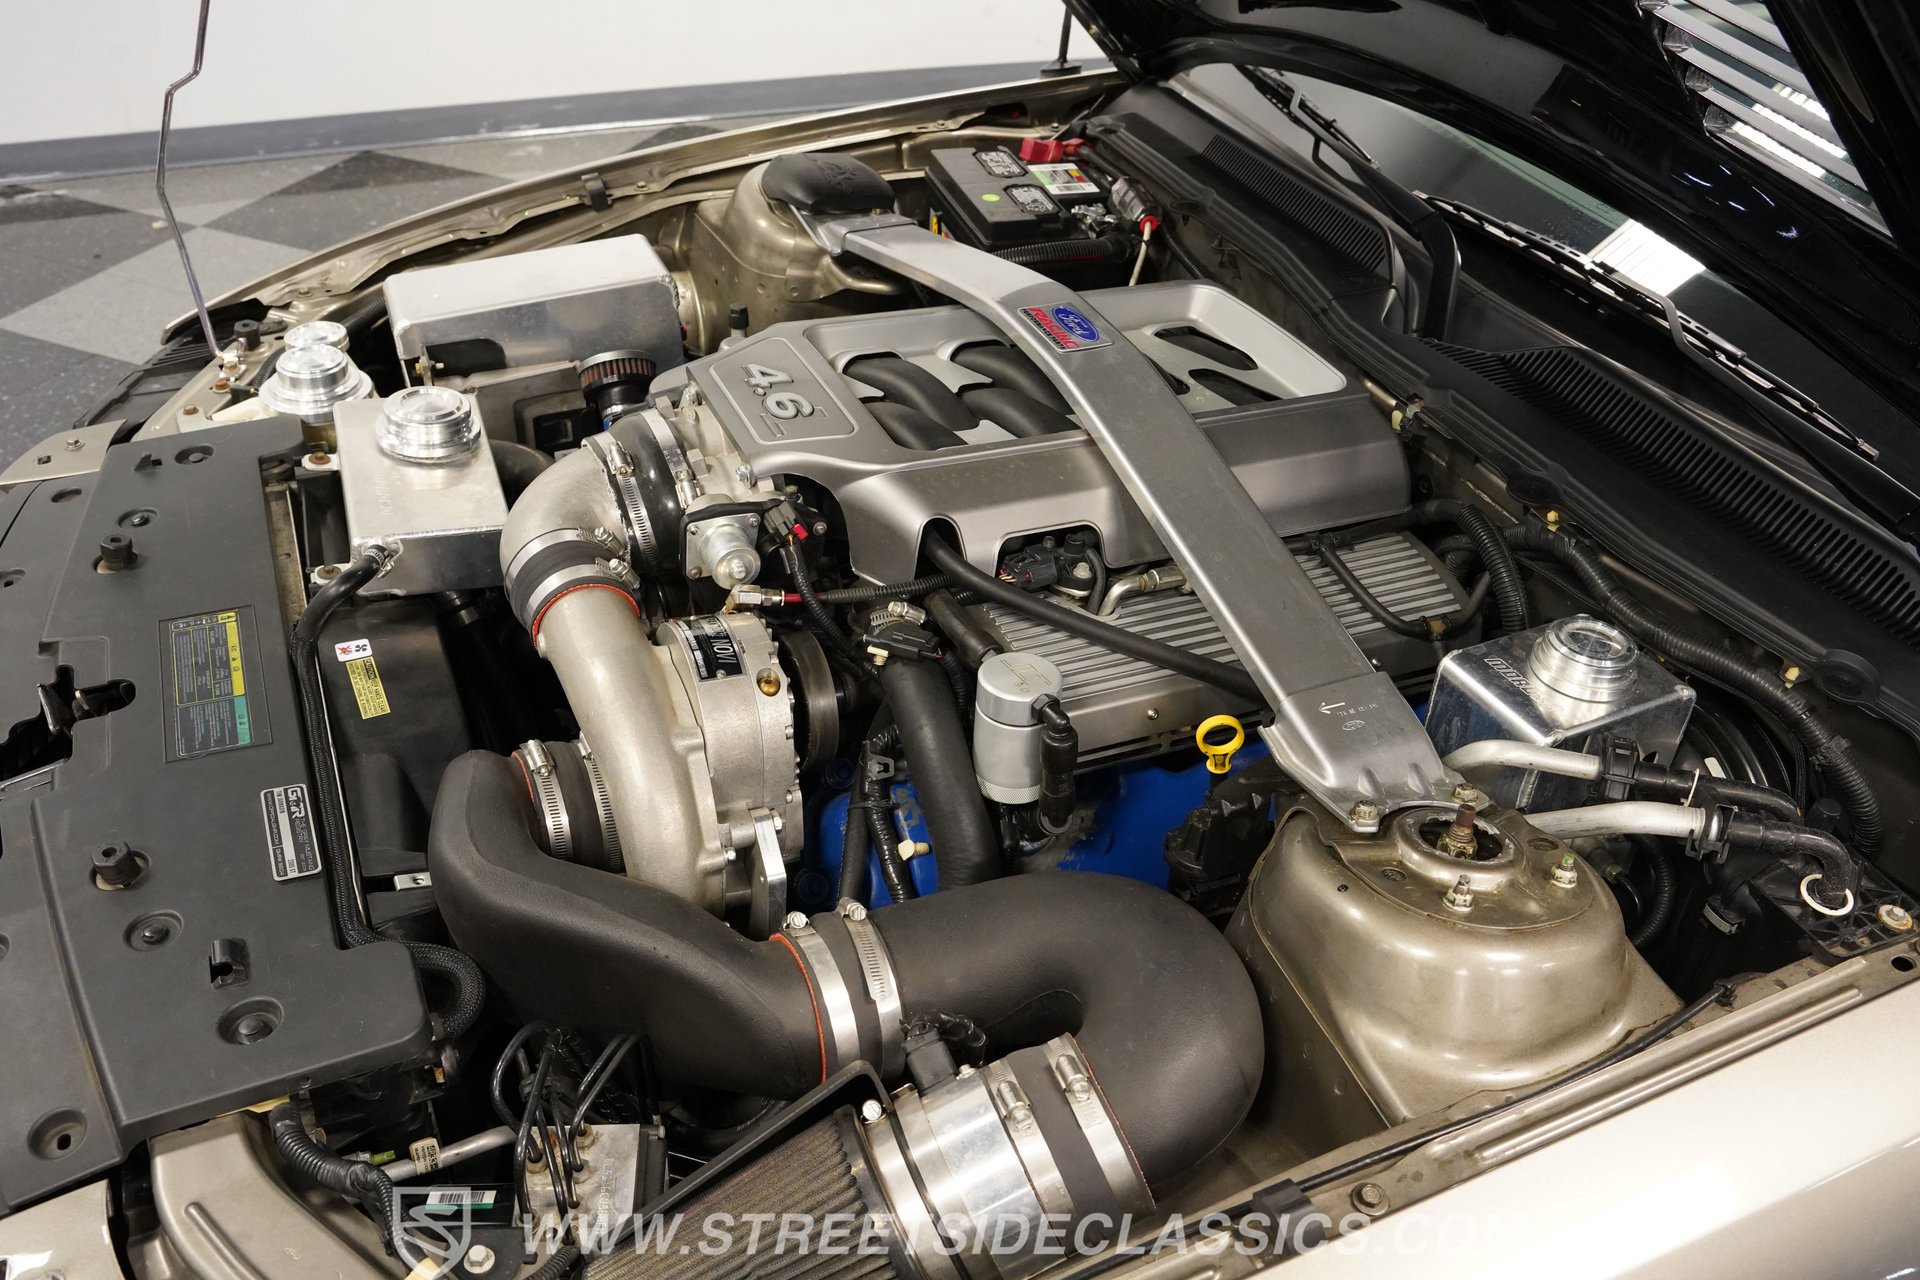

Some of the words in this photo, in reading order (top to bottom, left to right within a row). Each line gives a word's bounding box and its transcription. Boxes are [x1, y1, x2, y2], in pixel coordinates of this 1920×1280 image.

[1027, 307, 1081, 349] RACING
[364, 659, 376, 679] CAUTION
[305, 844, 315, 871] MUSTANG
